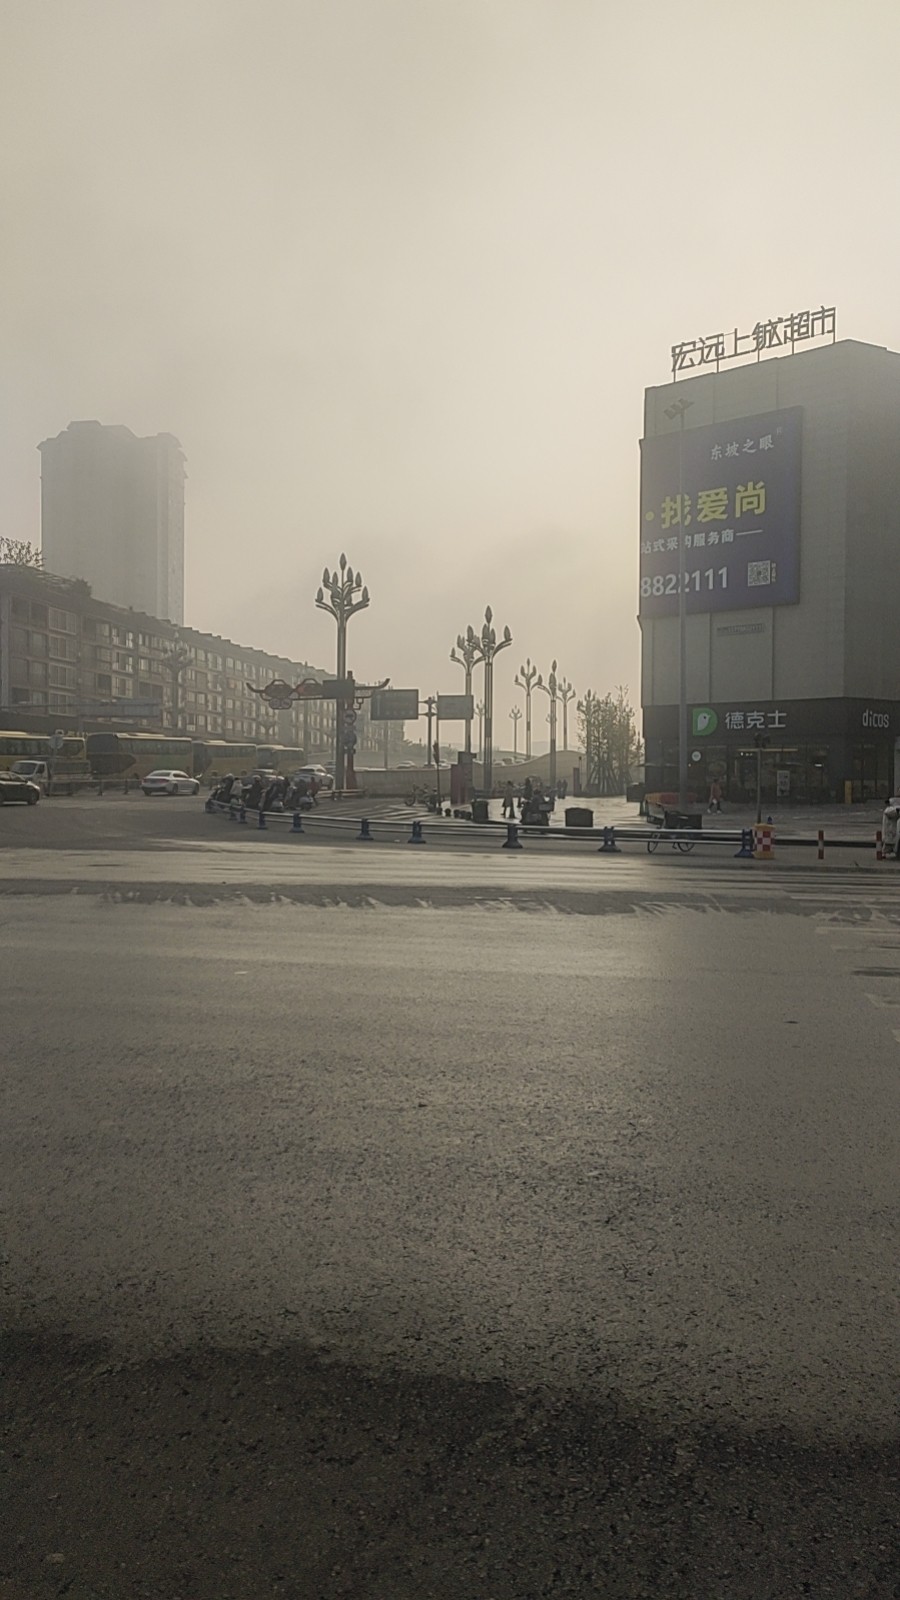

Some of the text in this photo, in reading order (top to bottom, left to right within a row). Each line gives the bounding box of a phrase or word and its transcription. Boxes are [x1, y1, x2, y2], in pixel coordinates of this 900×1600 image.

[711, 434, 774, 461] 东坡之眼
[725, 710, 787, 730] 德克士
[862, 708, 890, 728] dicos
